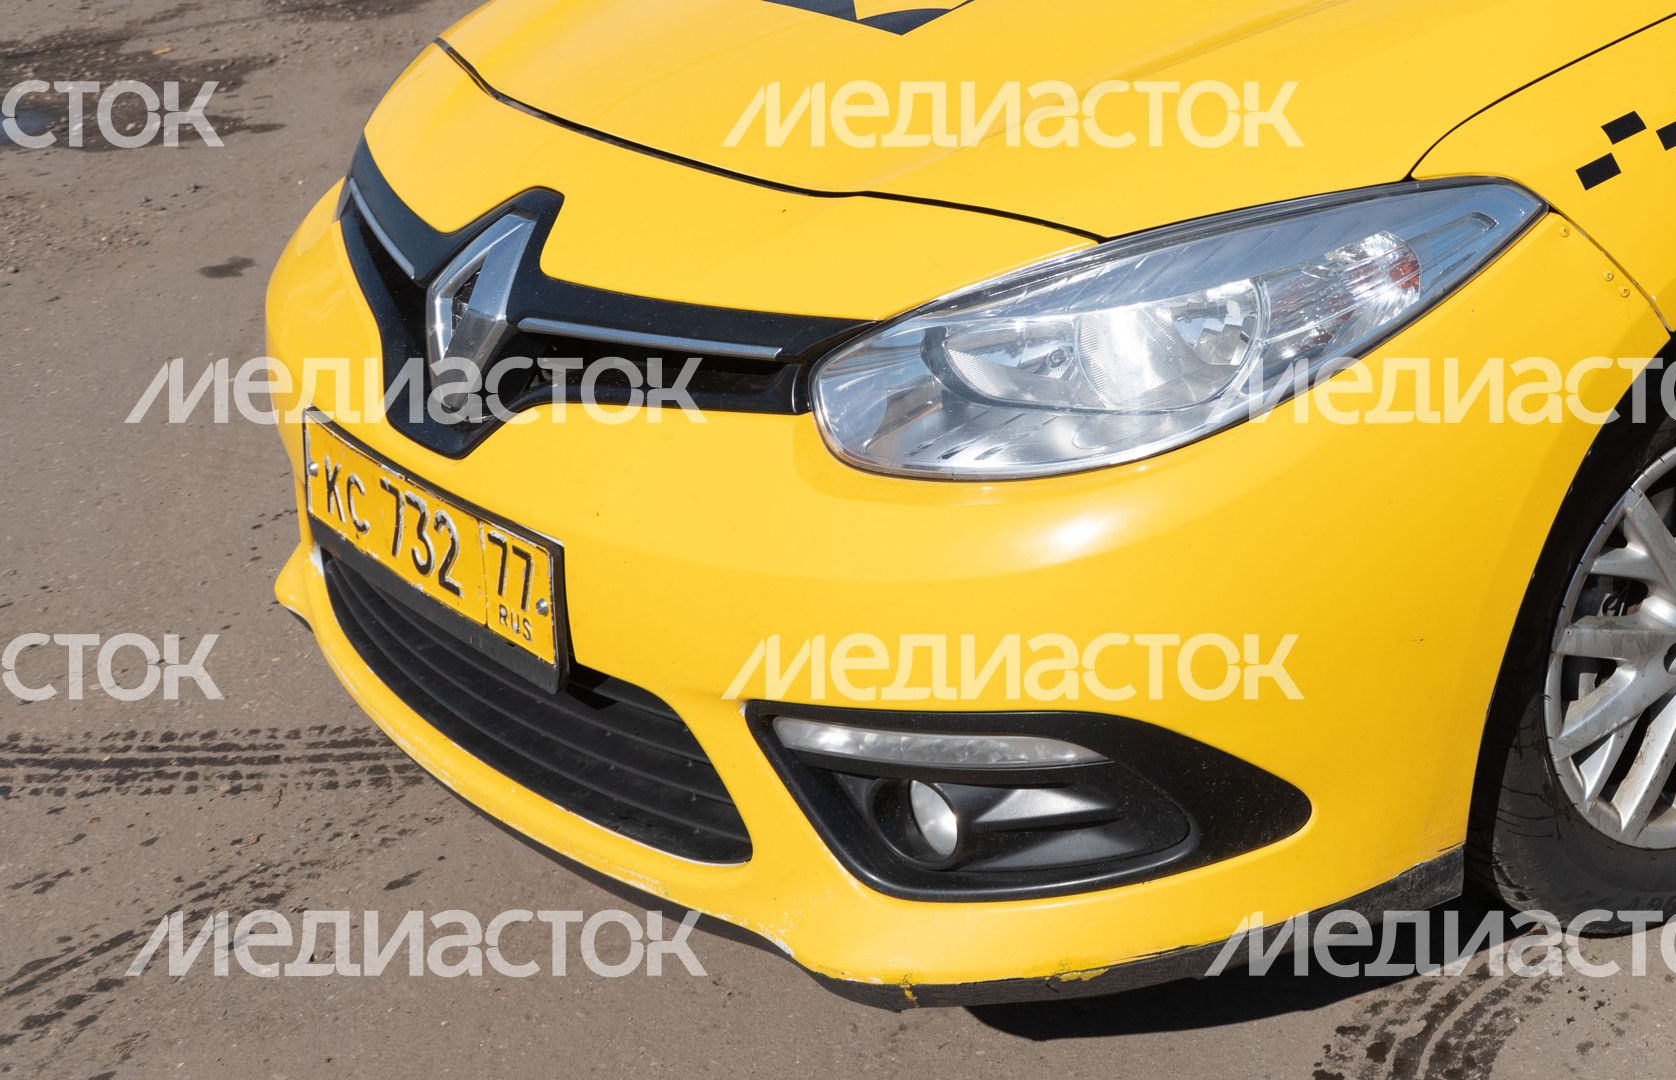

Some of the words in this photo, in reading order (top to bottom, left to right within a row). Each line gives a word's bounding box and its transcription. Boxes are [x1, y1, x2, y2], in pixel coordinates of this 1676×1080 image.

[379, 476, 465, 600] 732
[487, 530, 536, 612] 77
[498, 603, 534, 643] RUS
